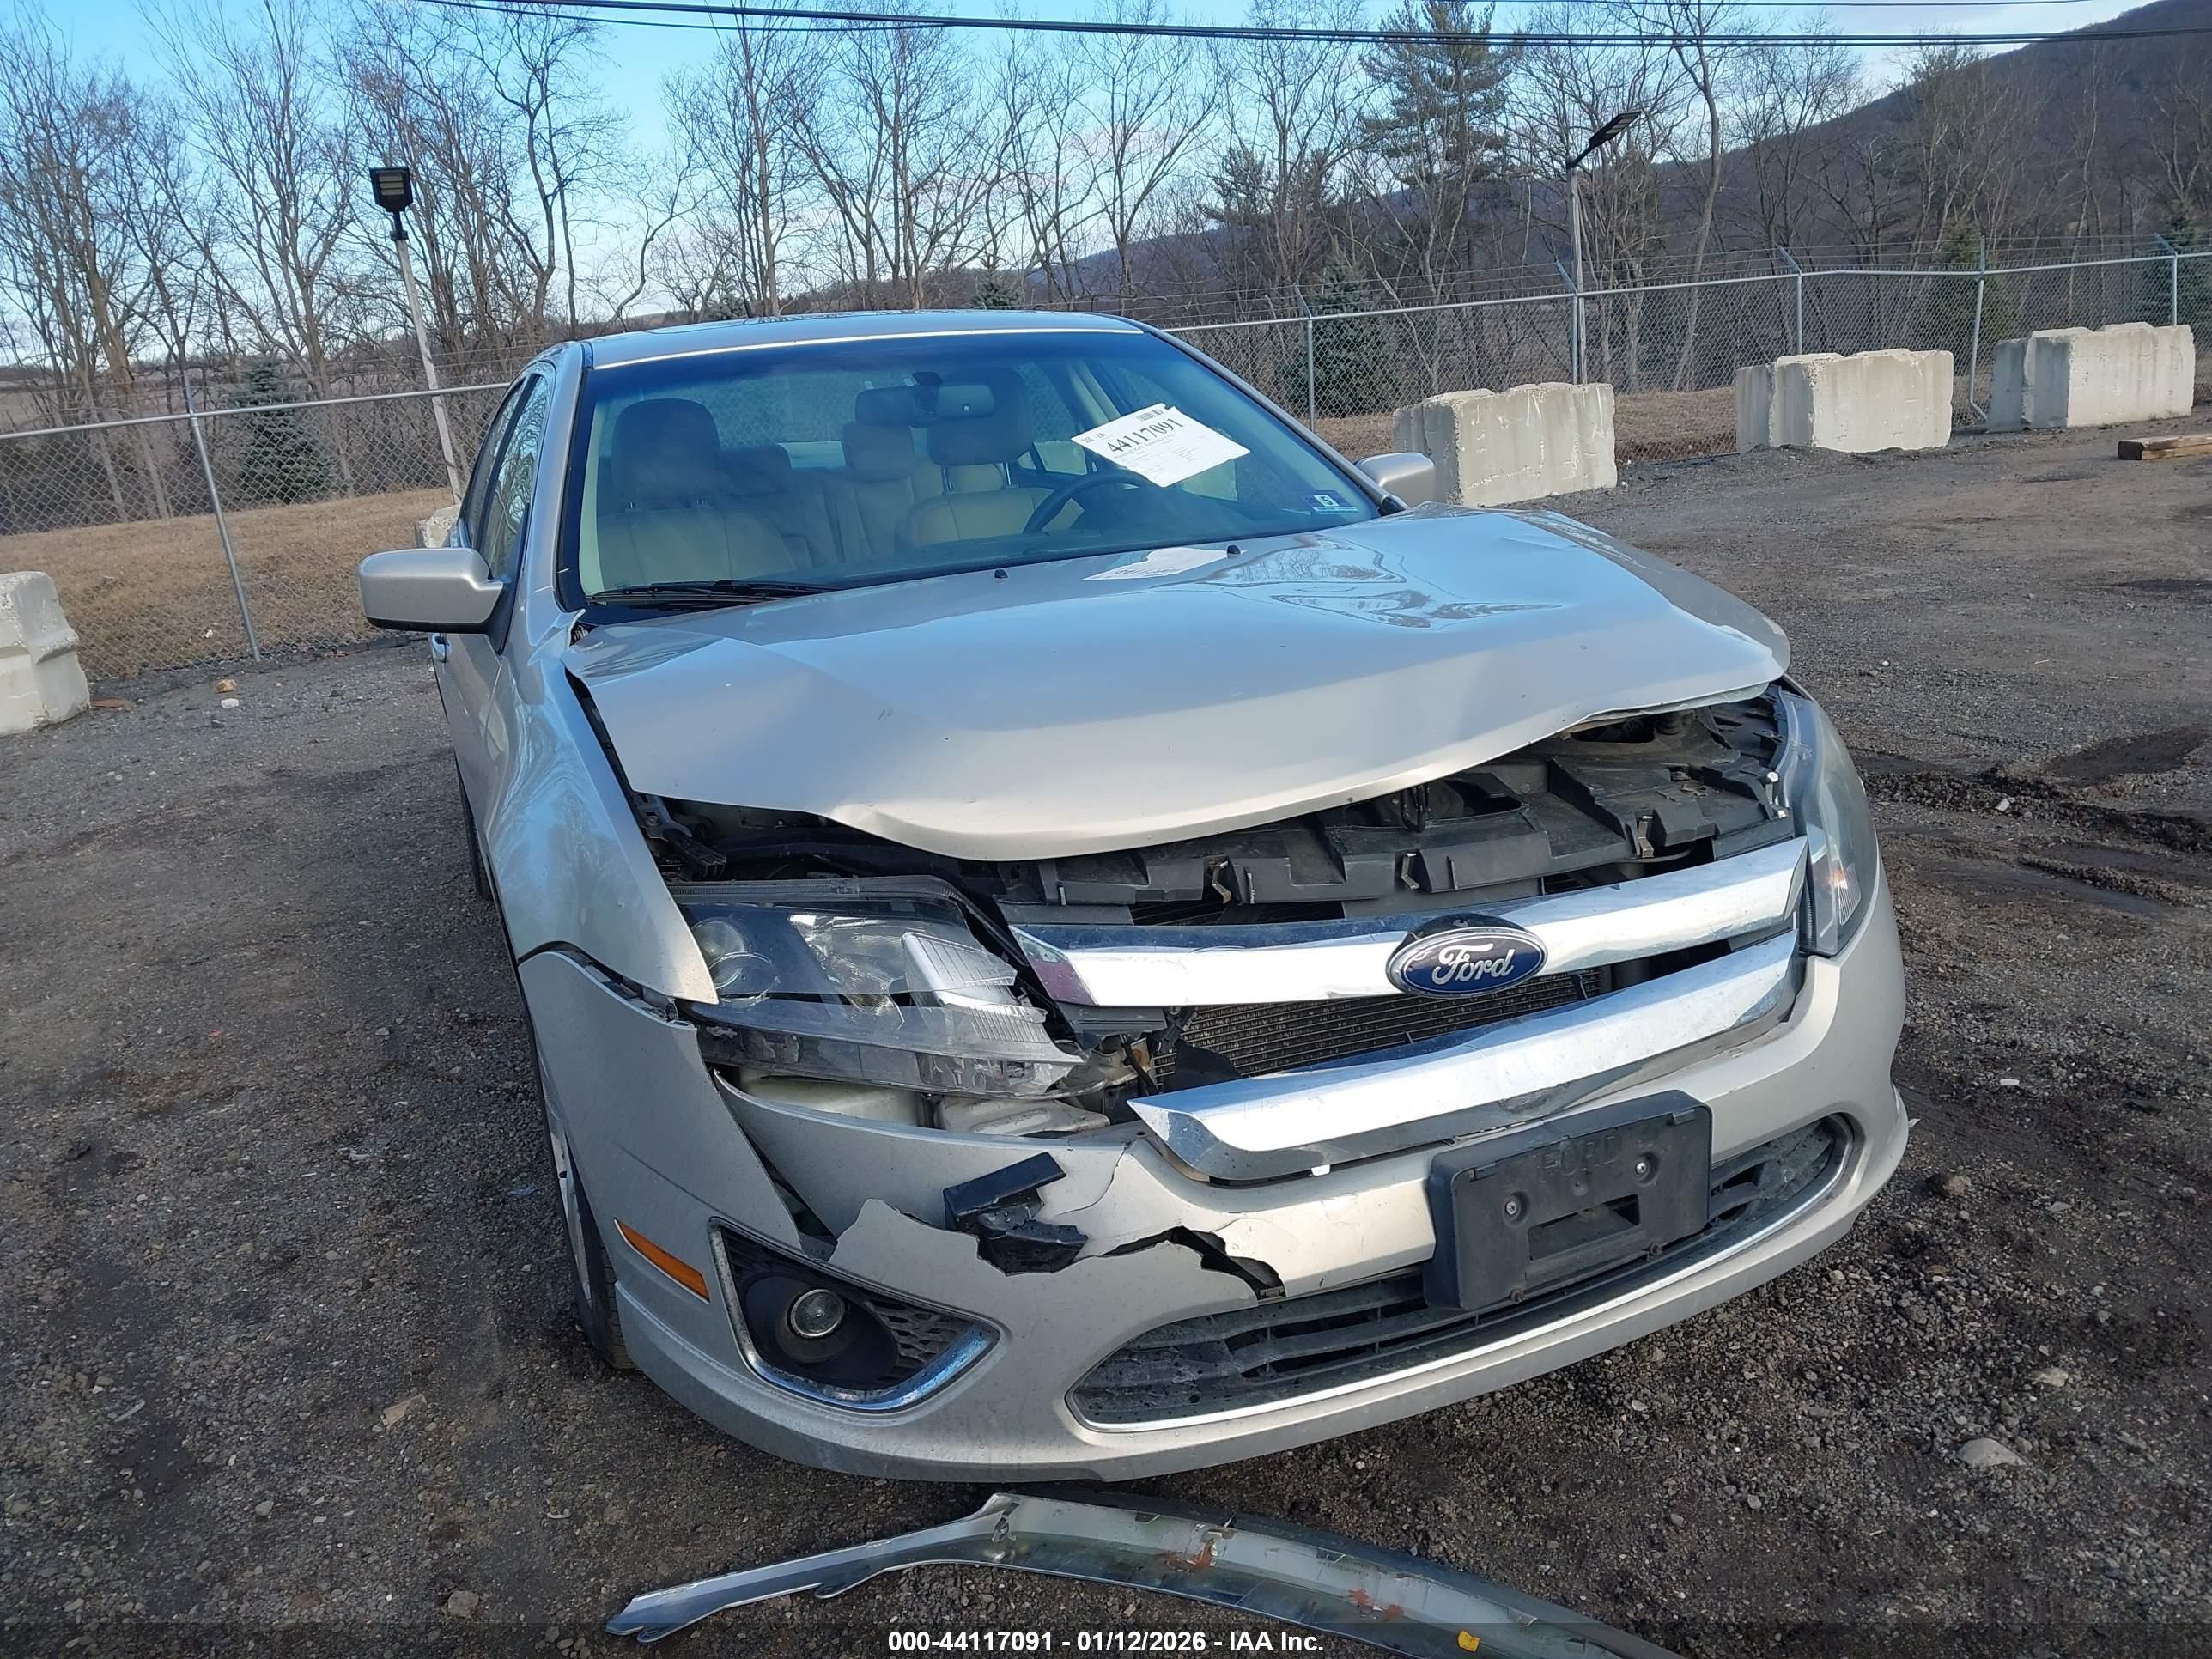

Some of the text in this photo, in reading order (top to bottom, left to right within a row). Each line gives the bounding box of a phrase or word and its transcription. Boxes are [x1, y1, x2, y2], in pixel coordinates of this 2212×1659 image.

[1107, 418, 1183, 453] 44117091
[1320, 495, 1334, 506] 5
[1431, 943, 1516, 985] Ford
[1539, 1132, 1622, 1182] FORD
